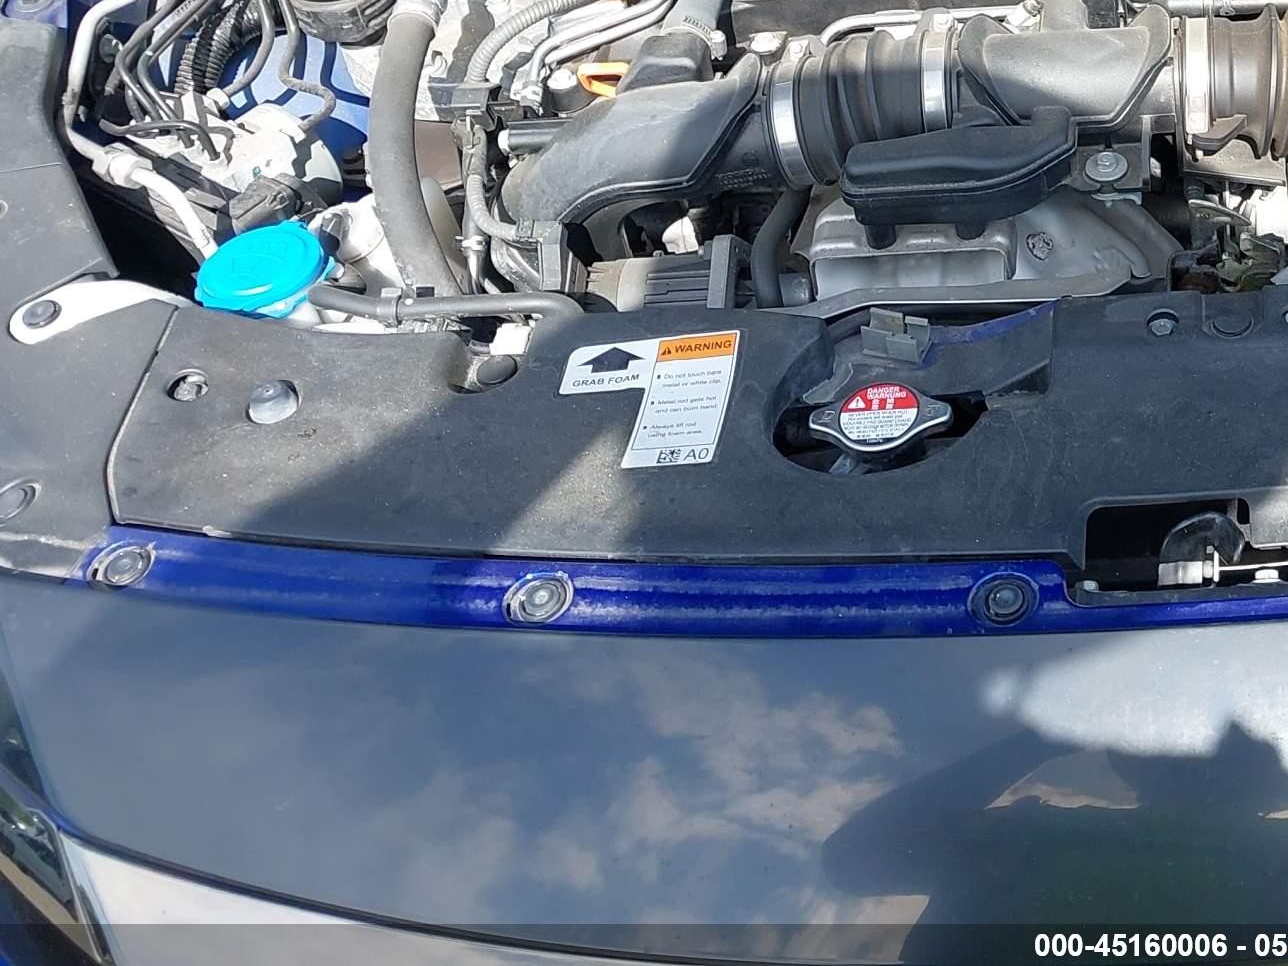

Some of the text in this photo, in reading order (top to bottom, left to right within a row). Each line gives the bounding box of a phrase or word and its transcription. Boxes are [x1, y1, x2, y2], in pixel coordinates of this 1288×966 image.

[674, 339, 732, 354] WARNING
[572, 374, 640, 388] GRAB FOAM
[867, 386, 900, 394] DANGER
[683, 448, 710, 461] A0
